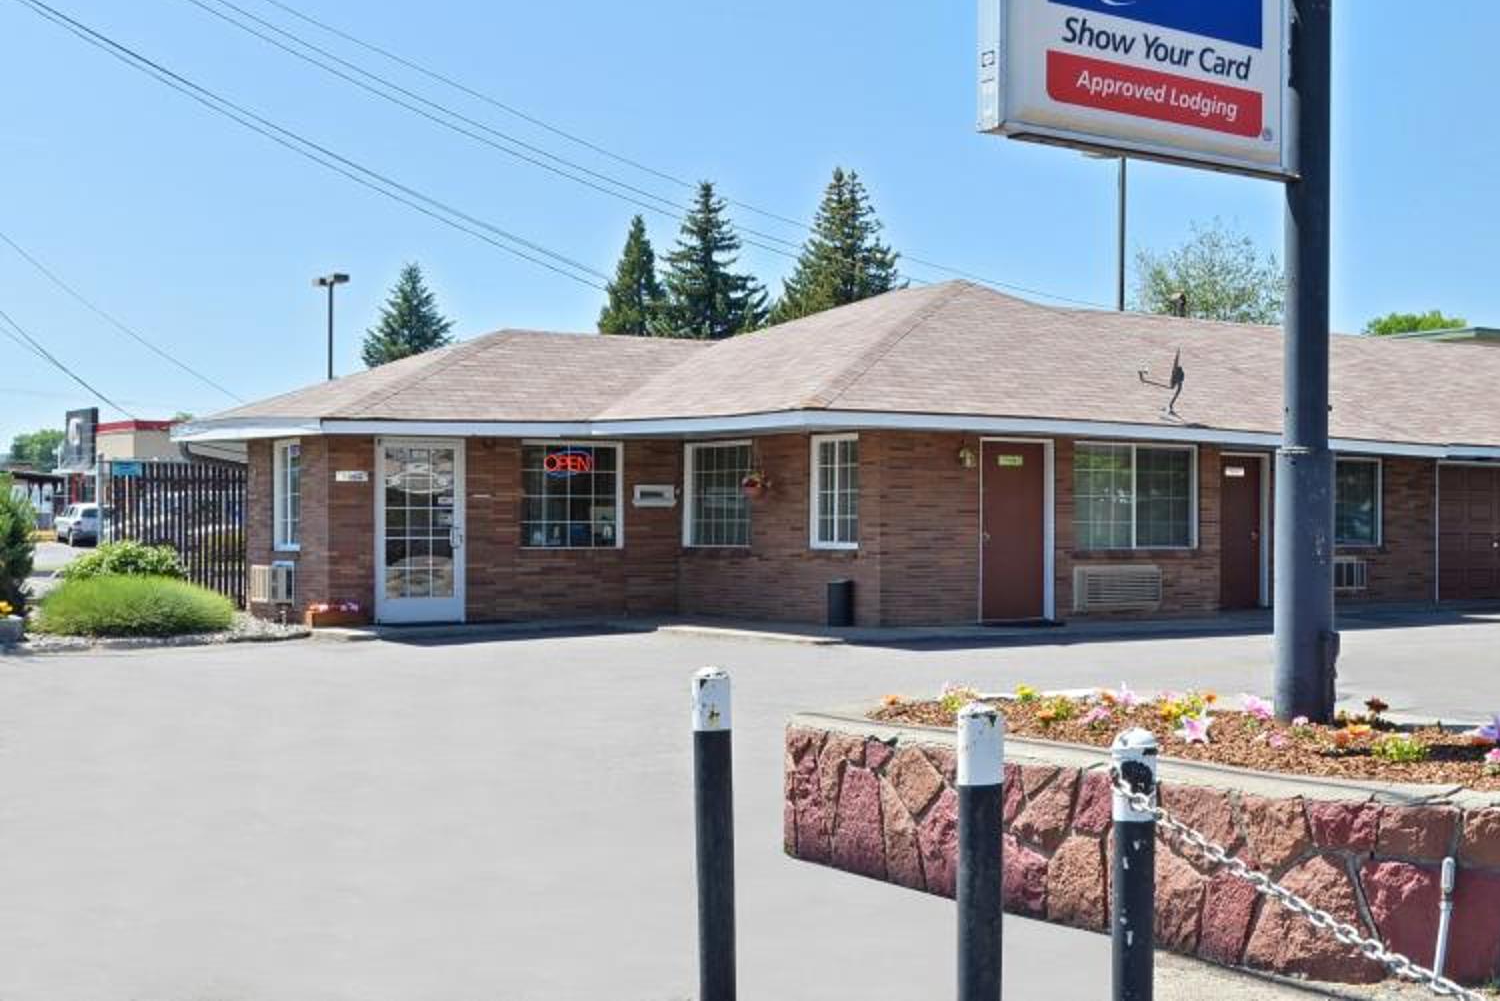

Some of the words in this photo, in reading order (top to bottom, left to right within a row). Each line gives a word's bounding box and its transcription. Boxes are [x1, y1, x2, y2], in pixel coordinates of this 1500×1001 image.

[1062, 16, 1136, 55] Show
[1143, 33, 1195, 68] Your
[1199, 47, 1252, 81] Card
[1075, 69, 1167, 104] Approved
[1169, 87, 1239, 122] Lodging
[543, 454, 589, 472] OPEN
